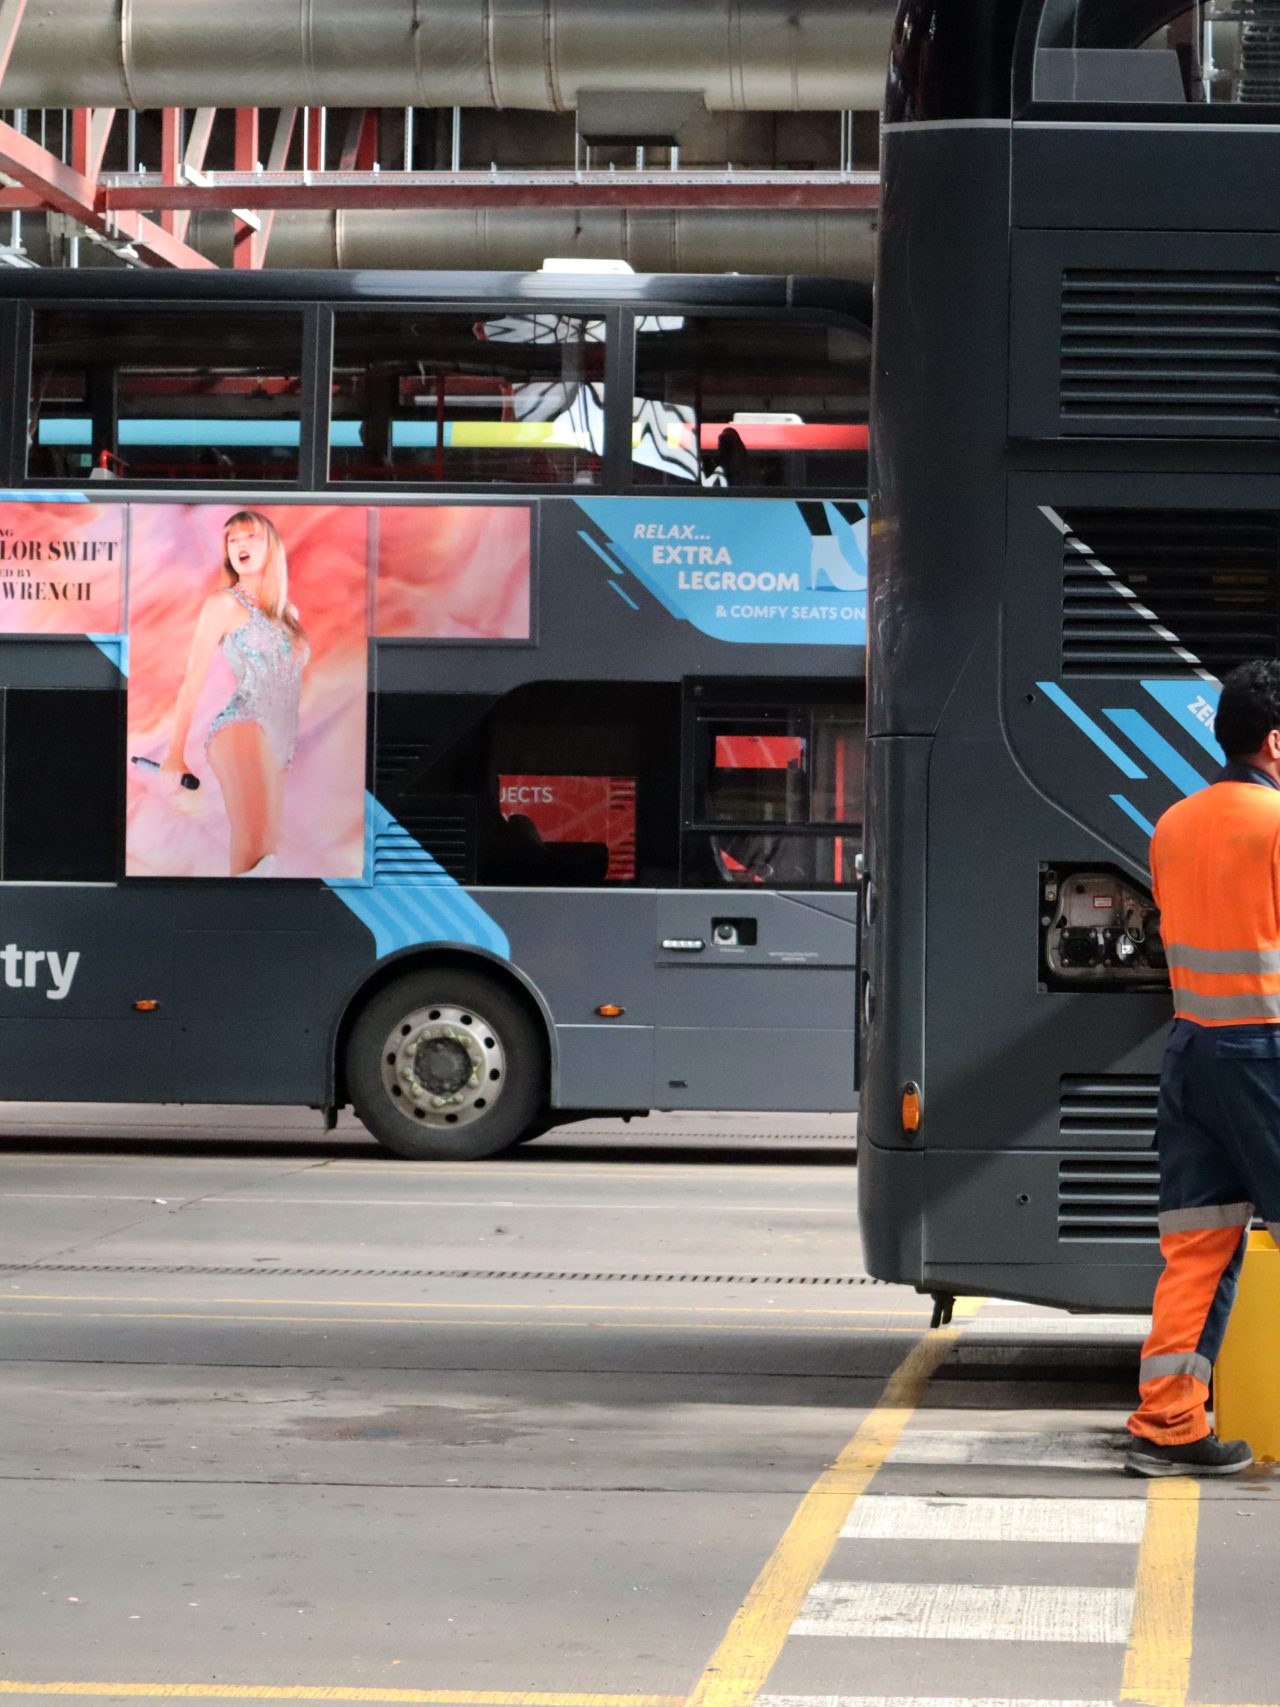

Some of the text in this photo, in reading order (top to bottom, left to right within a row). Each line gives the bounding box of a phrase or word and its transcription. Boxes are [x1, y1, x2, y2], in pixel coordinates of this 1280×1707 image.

[633, 524, 711, 540] RELAX...
[0, 541, 118, 561] LOR SWIFT
[652, 545, 732, 565] EXTRA
[17, 569, 31, 577] BY
[678, 571, 799, 592] LEGROOM
[2, 582, 91, 600] WRENCH
[715, 604, 727, 618] &
[730, 605, 787, 619] COMFY
[791, 606, 838, 619] SEATS
[0, 943, 80, 1000] try
